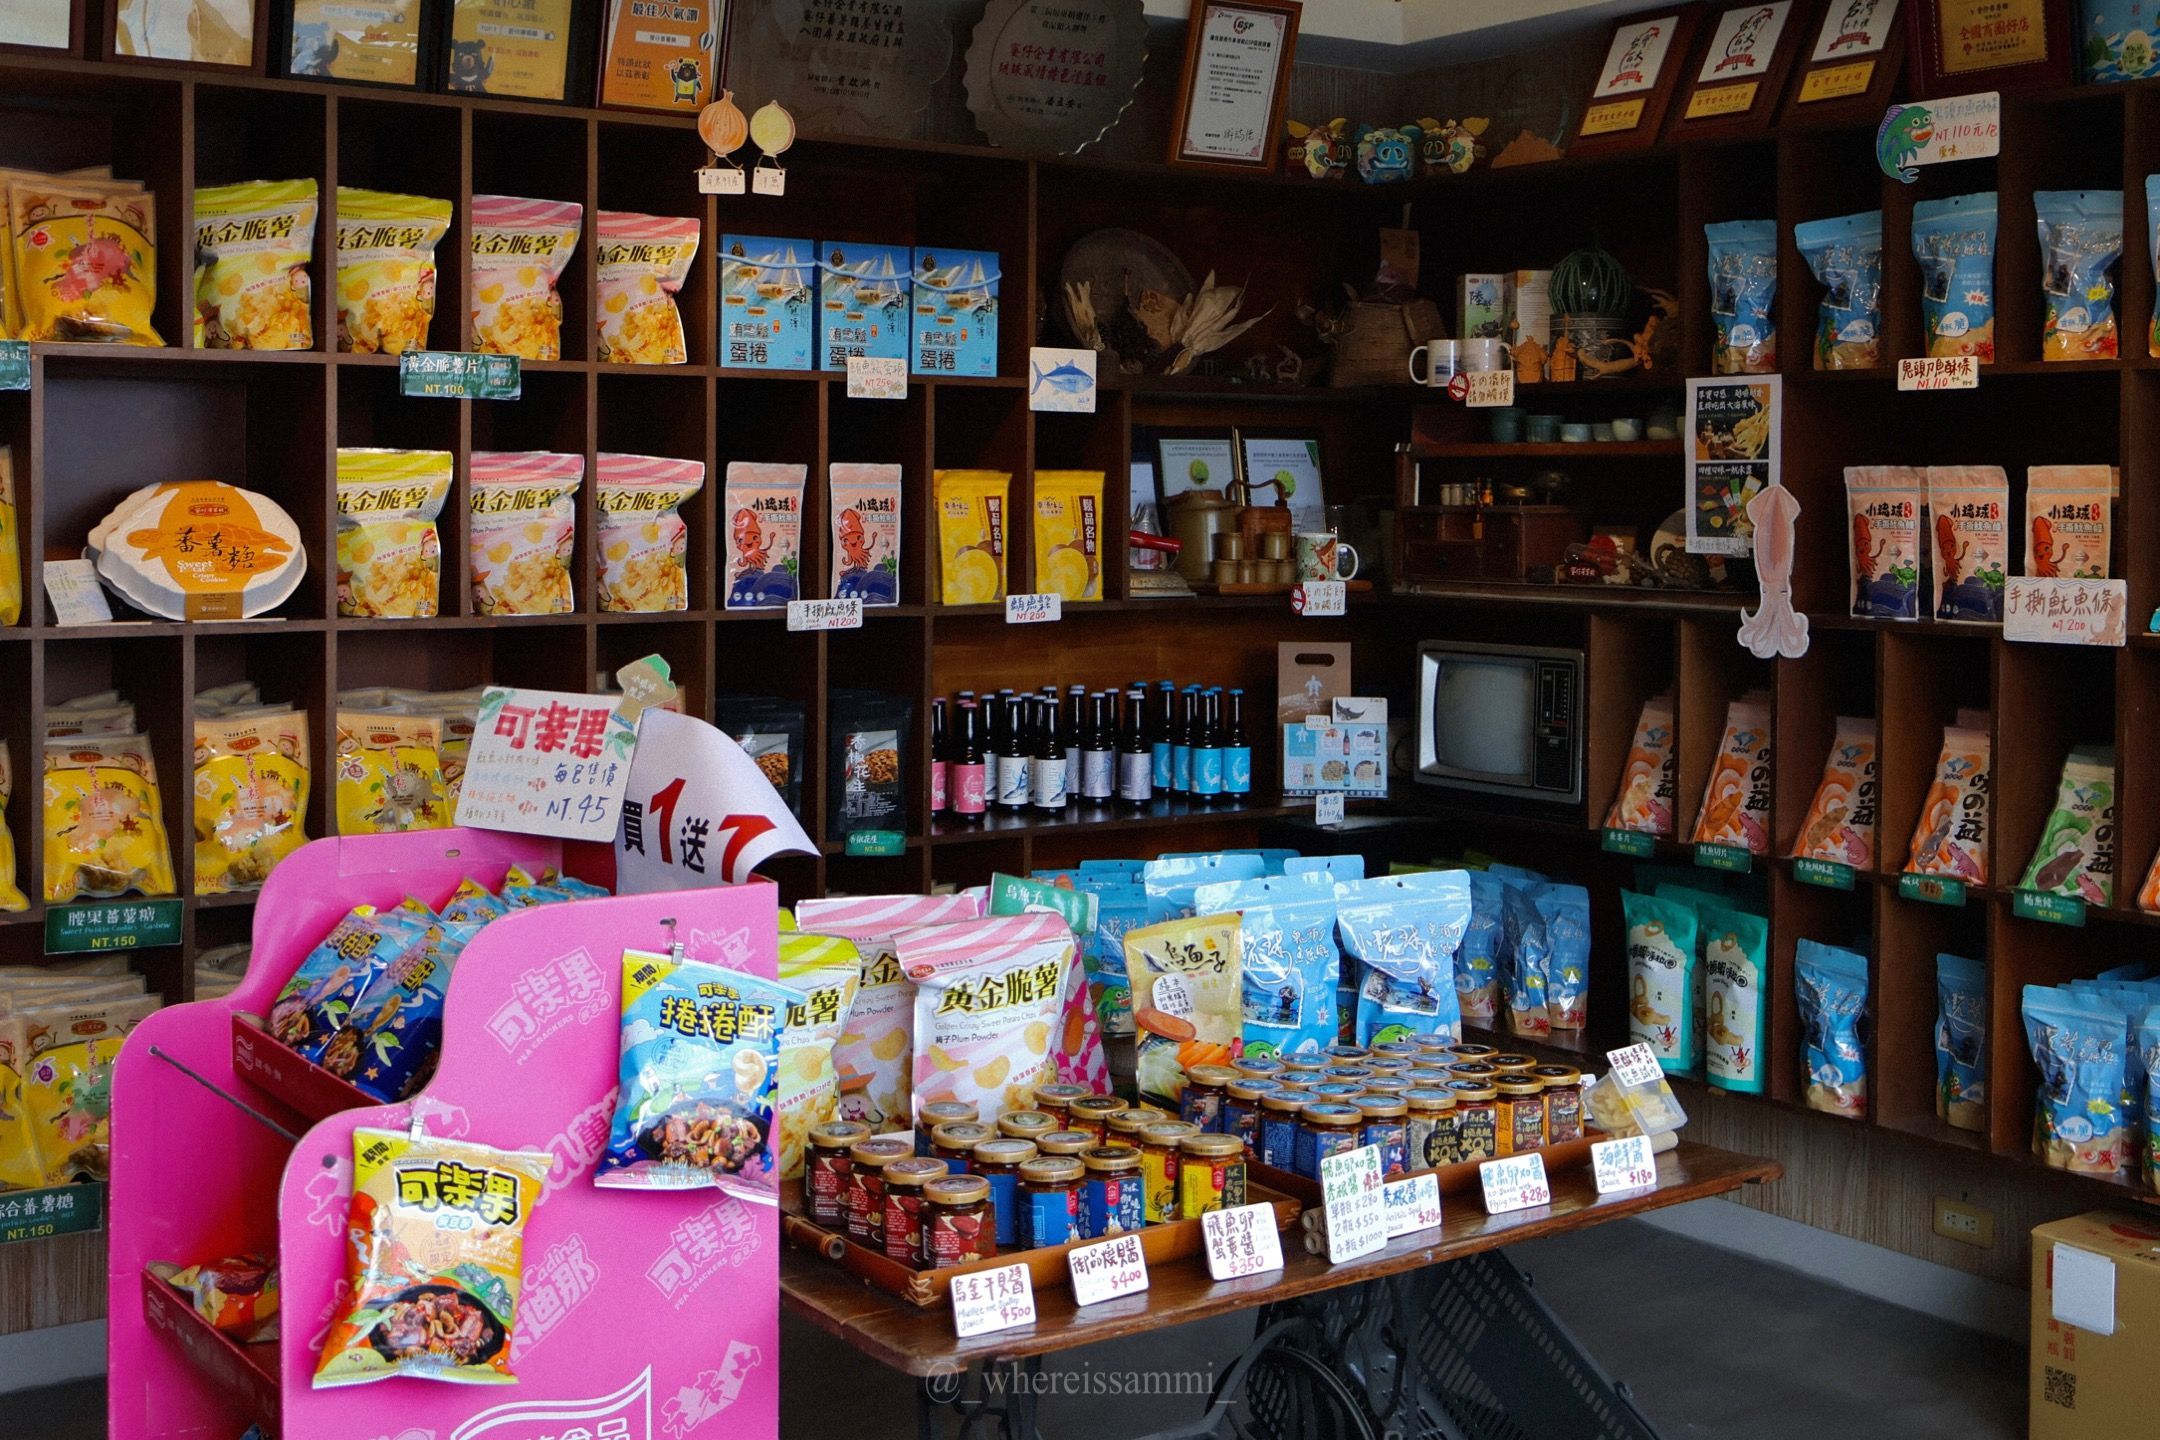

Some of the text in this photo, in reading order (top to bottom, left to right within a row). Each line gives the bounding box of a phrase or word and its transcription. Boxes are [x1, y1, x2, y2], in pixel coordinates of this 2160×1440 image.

[730, 342, 768, 363] 蛋捲
[920, 350, 956, 370] 蛋捲
[1864, 502, 1904, 518] 小琉球
[1950, 503, 1990, 519] 小琉球
[2048, 503, 2090, 520] 小琉球
[2008, 586, 2114, 617] 手撕魷魚條
[1004, 884, 1044, 904] 烏魚子
[90, 935, 137, 949] NT.150
[940, 963, 1060, 1014] 黃金脆薯
[661, 997, 776, 1044] 捲捲酥
[1600, 1138, 1644, 1168] 海鮮醬
[1629, 1169, 1653, 1186] $180
[1520, 1186, 1548, 1205] $280
[1207, 1211, 1255, 1237] 飛魚卵
[1418, 1207, 1440, 1225] $280
[7, 1224, 54, 1241] NT.150
[523, 1234, 582, 1293] Cadina
[1229, 1255, 1264, 1276] $350
[1111, 1270, 1142, 1290] $400
[1000, 1306, 1031, 1325] $500
